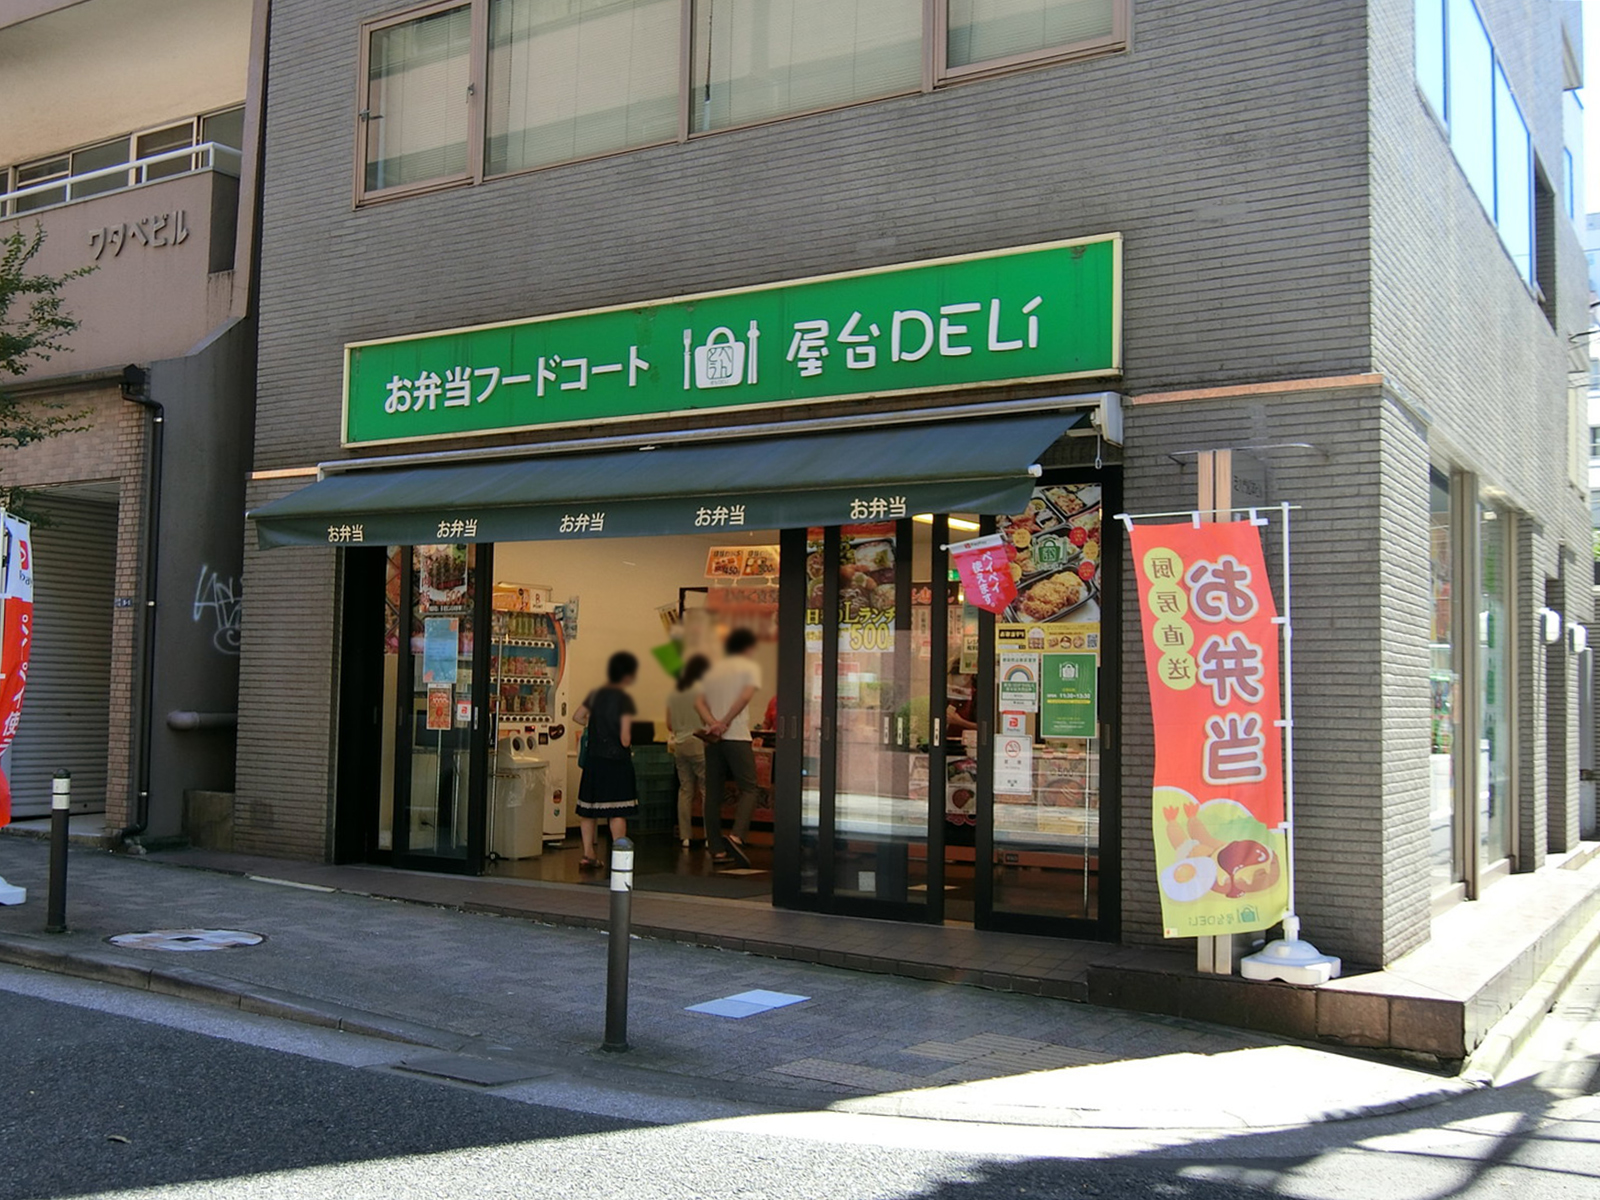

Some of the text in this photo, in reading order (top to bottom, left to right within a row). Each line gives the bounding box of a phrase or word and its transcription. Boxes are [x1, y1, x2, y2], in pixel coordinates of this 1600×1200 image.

[88, 210, 190, 260] ワタベビル
[384, 345, 650, 414] お弁当フードコート
[694, 505, 746, 527] お弁当
[850, 496, 907, 520] お弁当
[327, 524, 364, 543] お弁当
[436, 518, 478, 539] お弁当
[559, 512, 605, 533] お弁当
[982, 551, 1000, 593] ペイペイ
